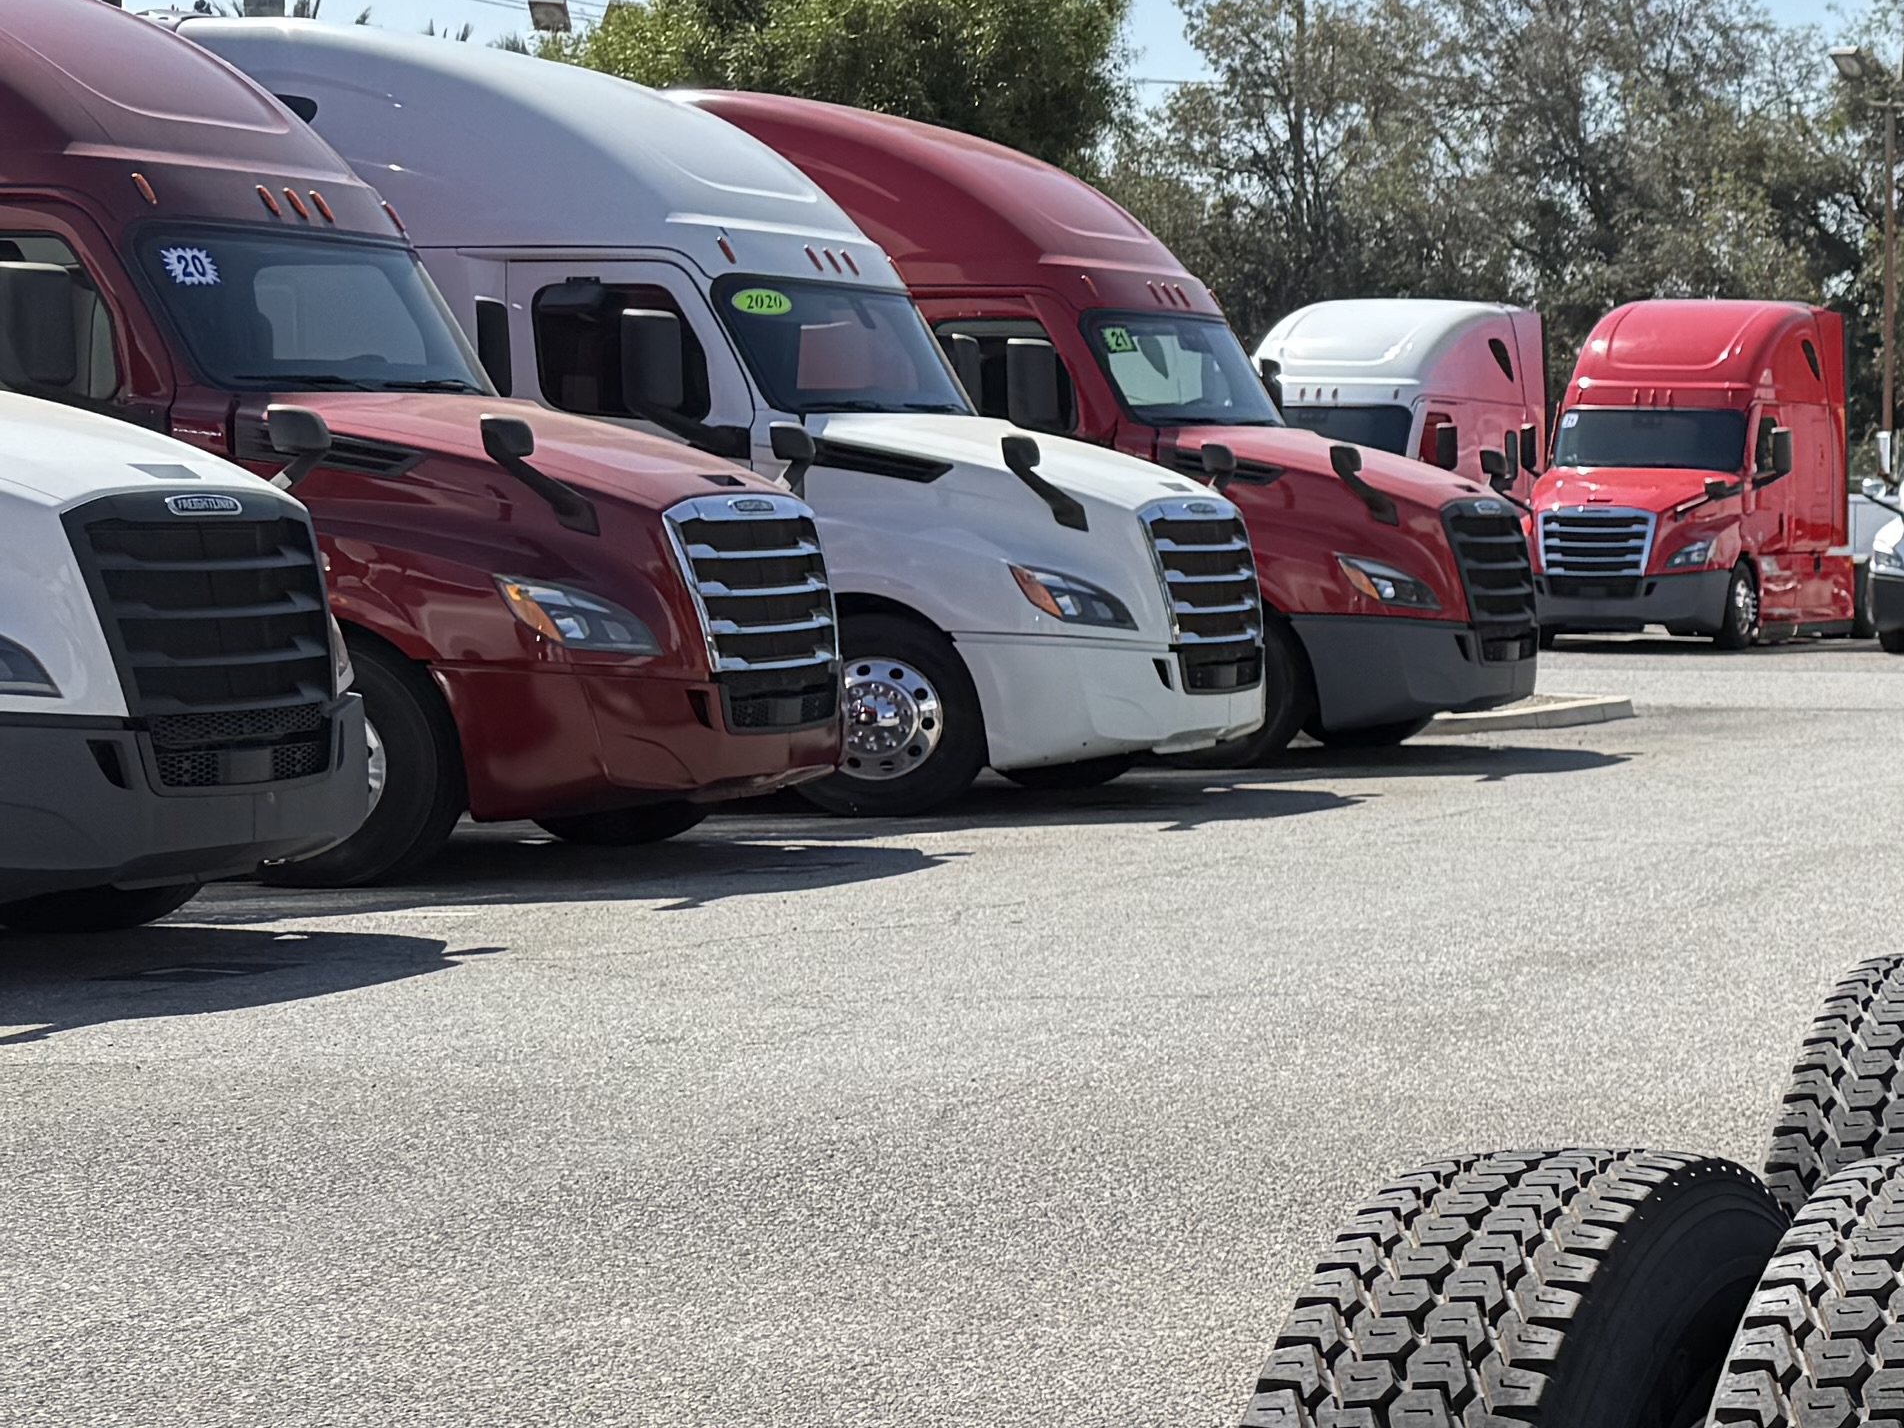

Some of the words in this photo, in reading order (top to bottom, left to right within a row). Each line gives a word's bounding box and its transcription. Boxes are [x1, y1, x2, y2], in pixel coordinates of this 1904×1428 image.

[176, 254, 206, 278] 20
[746, 294, 783, 310] 2020
[1110, 330, 1128, 347] 21
